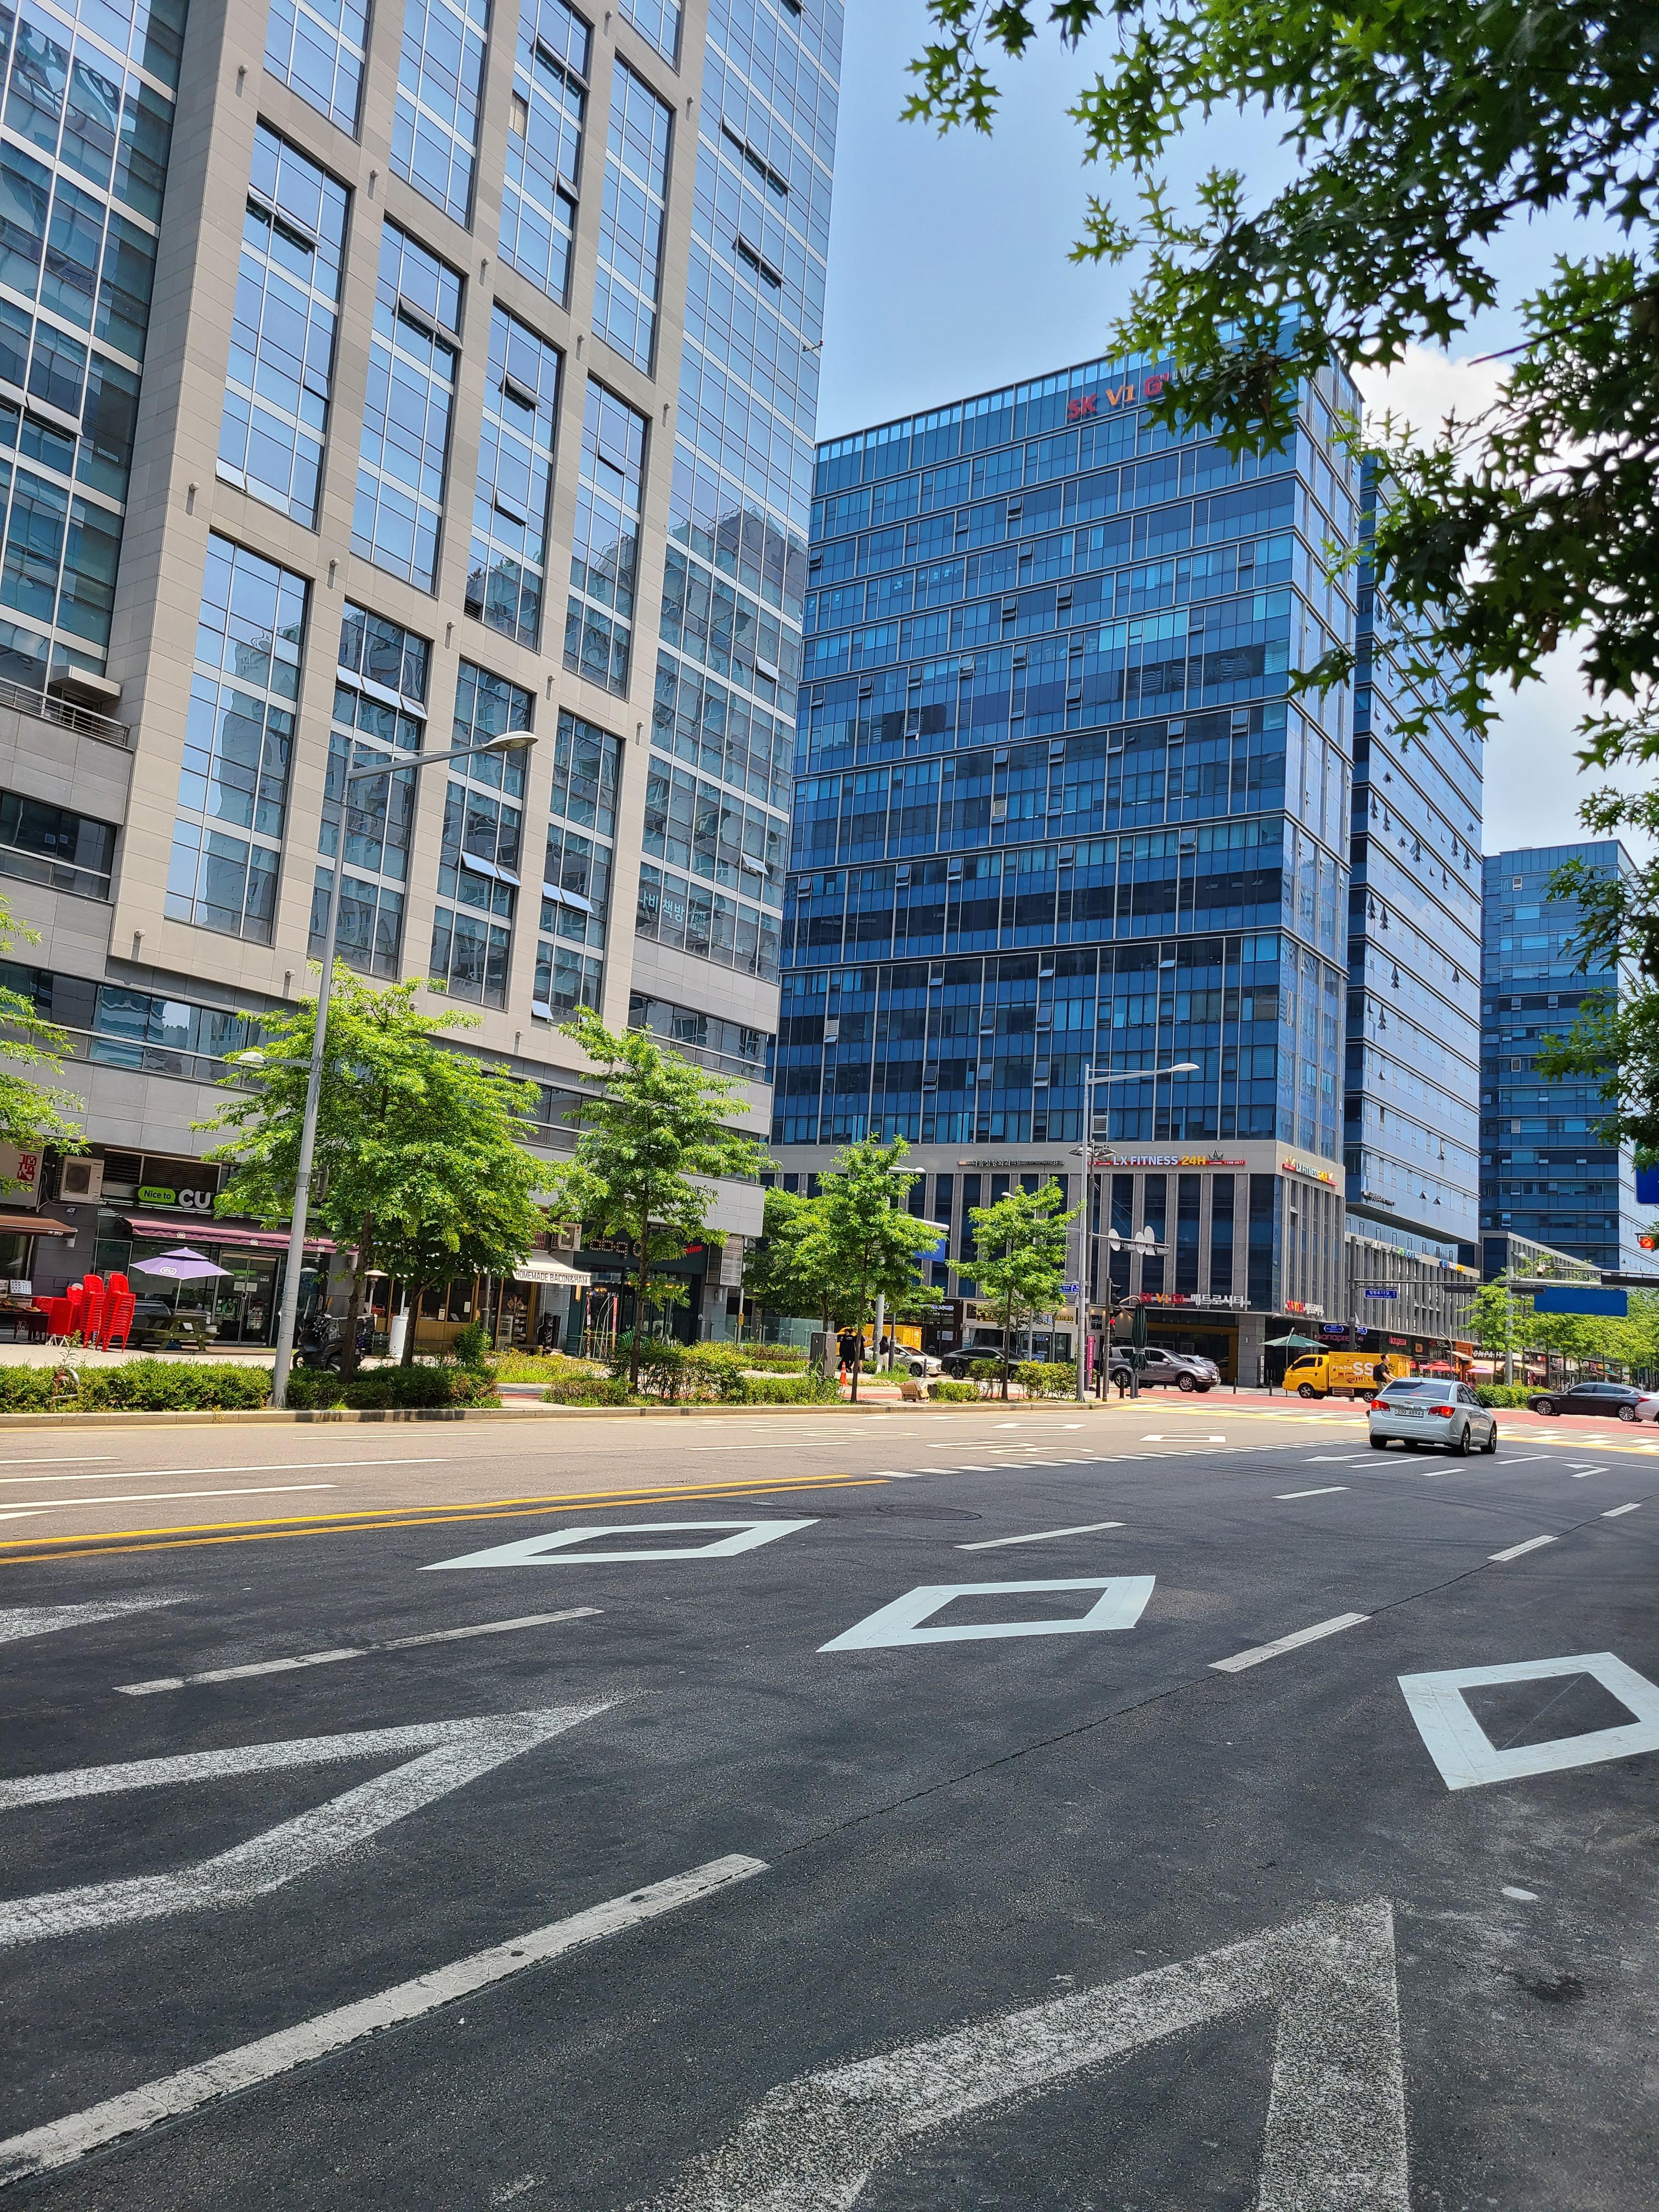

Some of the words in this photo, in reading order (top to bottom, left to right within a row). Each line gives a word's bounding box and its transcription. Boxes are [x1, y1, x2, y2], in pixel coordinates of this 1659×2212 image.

[1068, 393, 1097, 419] SK
[1106, 383, 1136, 406] V1
[1113, 1155, 1128, 1166] LX
[1130, 1155, 1178, 1166] FITNESS
[1181, 1155, 1206, 1165] 24H
[1302, 1165, 1318, 1179] FITNESS
[144, 1189, 163, 1199] Nice
[178, 1189, 211, 1209] CU
[516, 1270, 548, 1281] HOMEMADE
[550, 1273, 587, 1284] BACON&HAM
[1140, 1293, 1153, 1302] SK
[1155, 1293, 1169, 1302] V1
[1191, 1294, 1244, 1307] 메트로시티
[1472, 1350, 1503, 1358] OMPANY
[1353, 1362, 1374, 1376] SS
